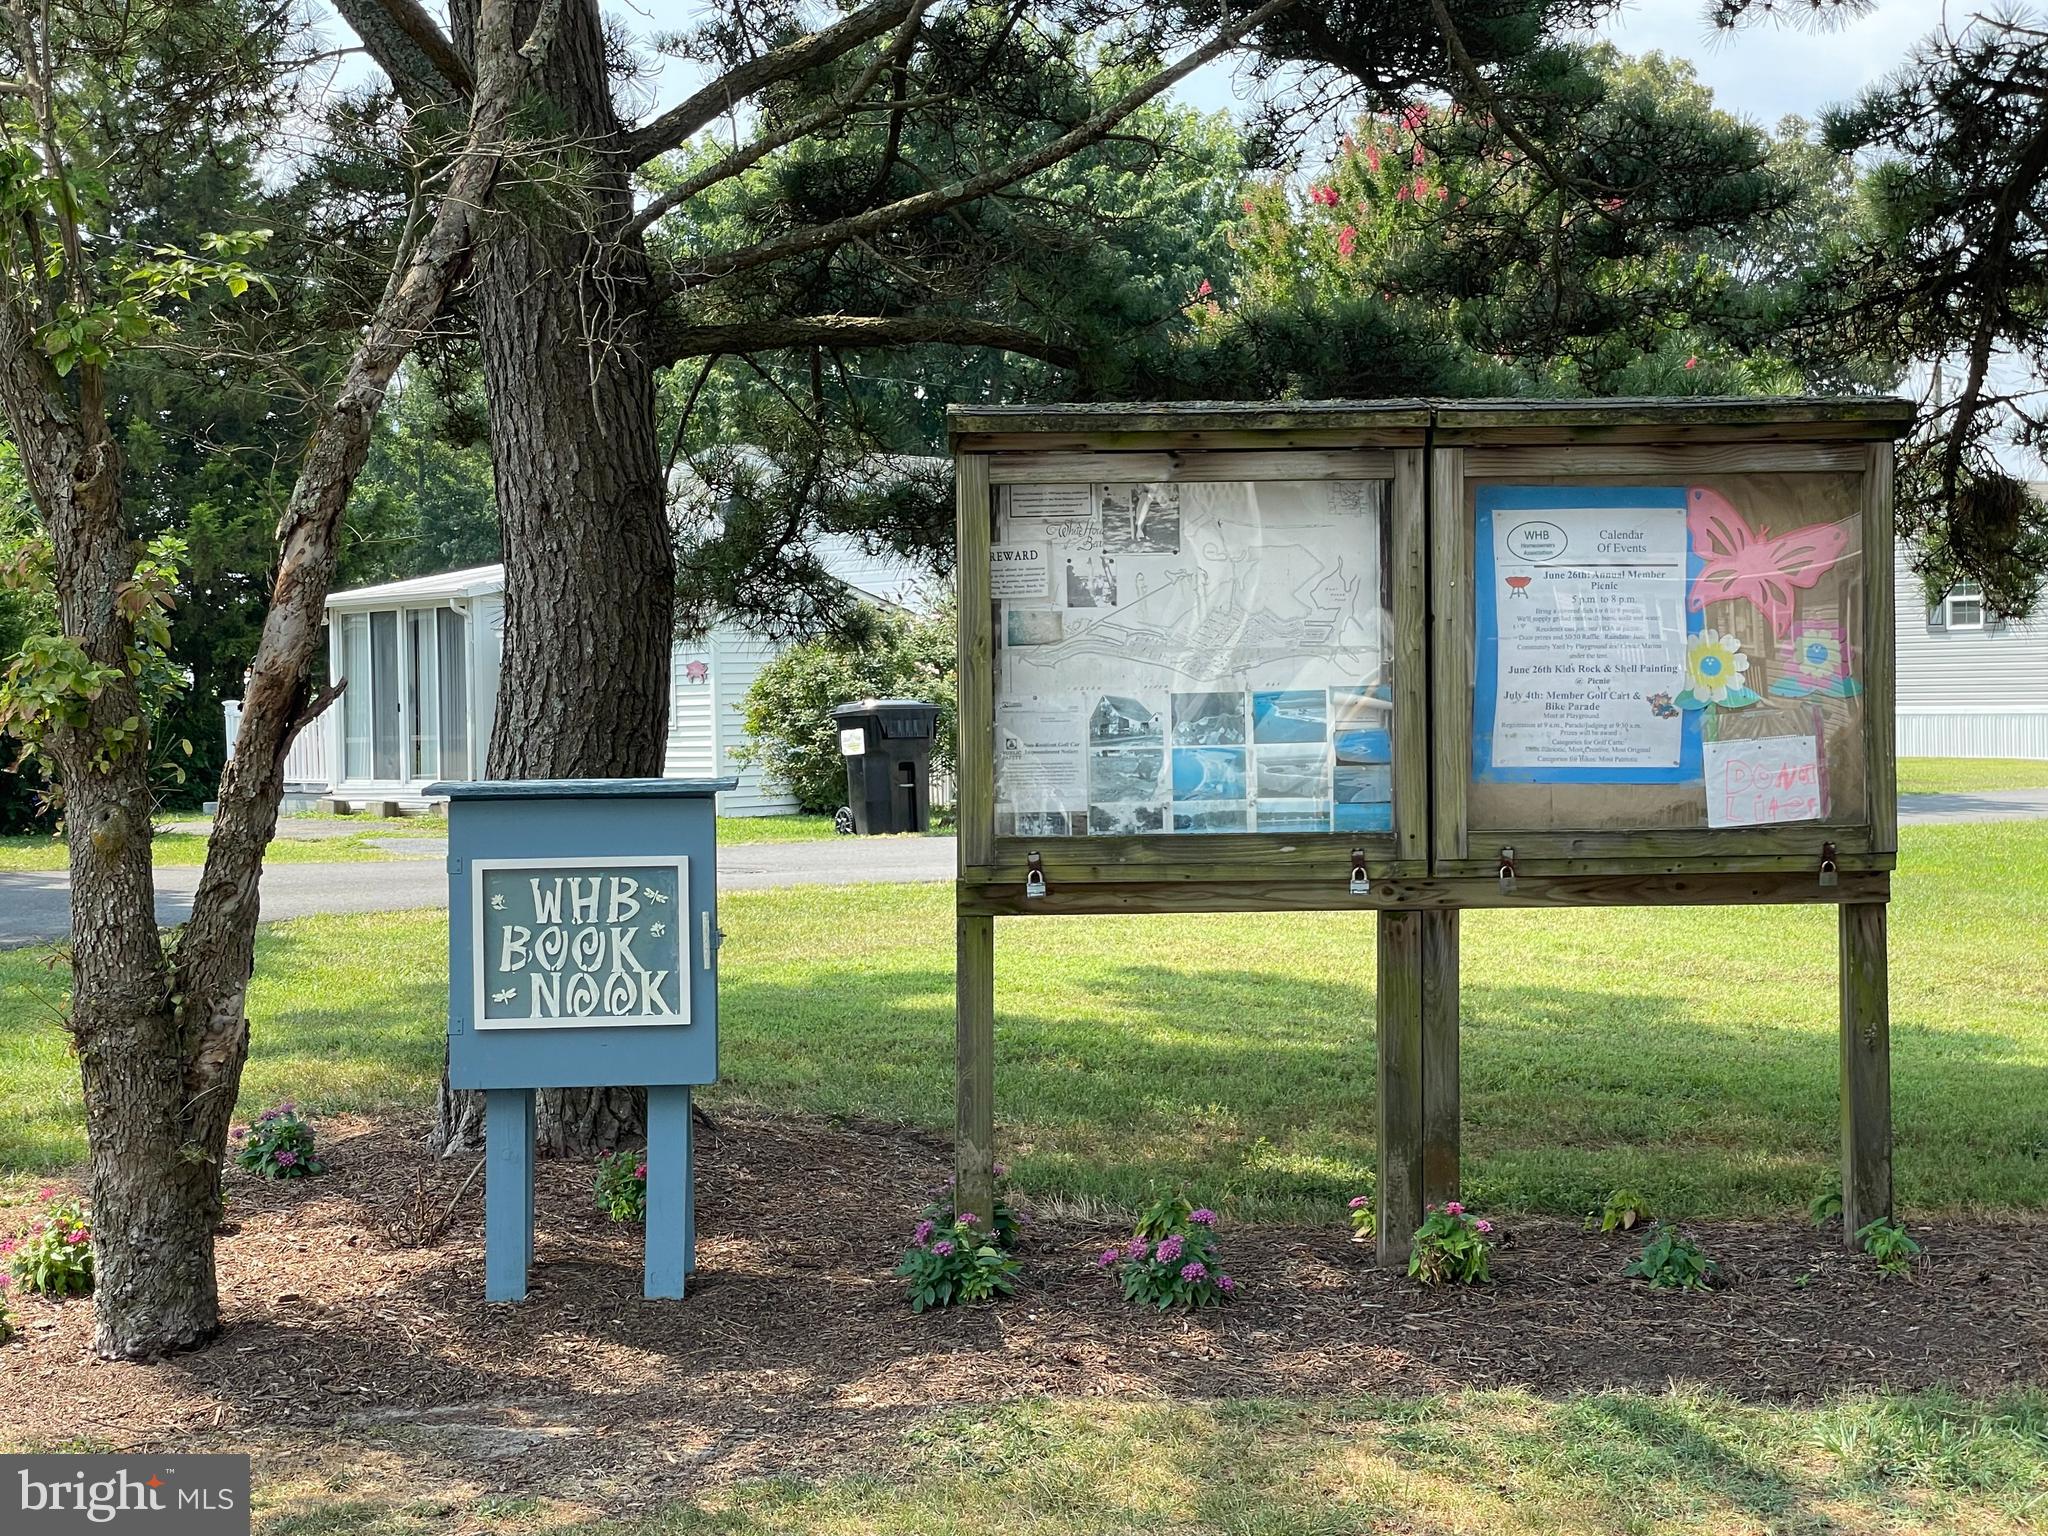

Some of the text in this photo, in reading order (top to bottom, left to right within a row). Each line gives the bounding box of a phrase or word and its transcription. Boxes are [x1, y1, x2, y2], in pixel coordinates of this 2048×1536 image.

[1524, 530, 1550, 540] WHB
[1599, 529, 1644, 541] Calendar
[1597, 543, 1647, 553] Of Events
[990, 550, 1038, 562] REWARD
[1543, 570, 1666, 580] June 26th: Annual Member
[1591, 581, 1619, 590] Picnic
[1571, 595, 1578, 603] 5
[1600, 594, 1609, 603] to
[1611, 594, 1617, 603] 8
[1508, 665, 1531, 675] June
[1532, 665, 1552, 674] 26th
[1578, 664, 1601, 674] Rock
[1603, 664, 1612, 673] &
[1615, 664, 1638, 673] Shell
[1639, 663, 1679, 675] Painting
[1587, 677, 1611, 685] Picnic
[1503, 690, 1641, 703] July 4th: Member Golf Cart &
[1545, 702, 1601, 711] Bike Parade
[529, 876, 642, 926] WHB
[499, 924, 646, 974] BOOK
[529, 970, 676, 1018] NOOK
